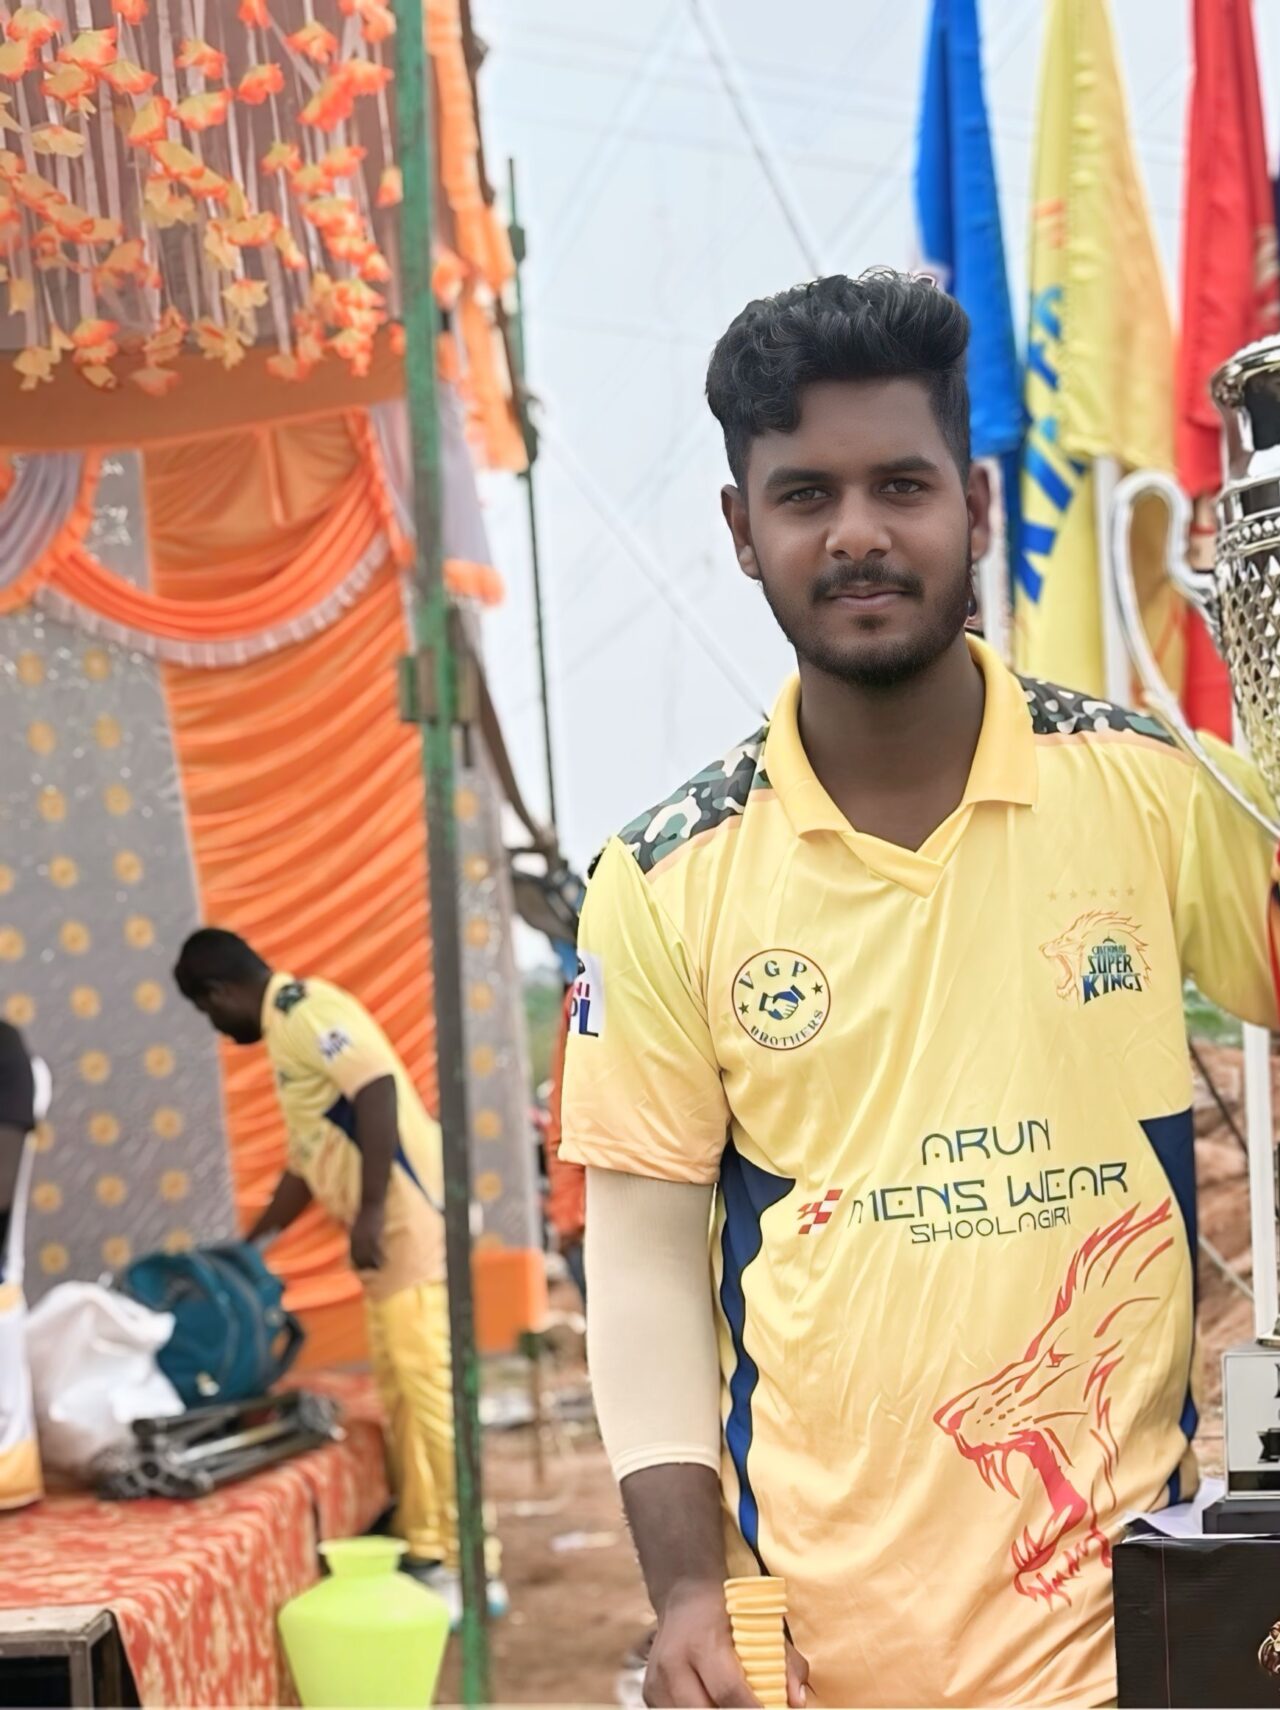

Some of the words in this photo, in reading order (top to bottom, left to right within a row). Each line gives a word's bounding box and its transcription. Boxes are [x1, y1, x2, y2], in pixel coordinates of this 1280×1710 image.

[1087, 953, 1133, 975] SUPER
[1081, 972, 1143, 1005] KINGS
[750, 1009, 824, 1047] BROTHERS
[921, 1118, 1052, 1166] ARUN
[1006, 1161, 1129, 1208] WEAR
[909, 1205, 1072, 1245] SHOOLAGIRI
